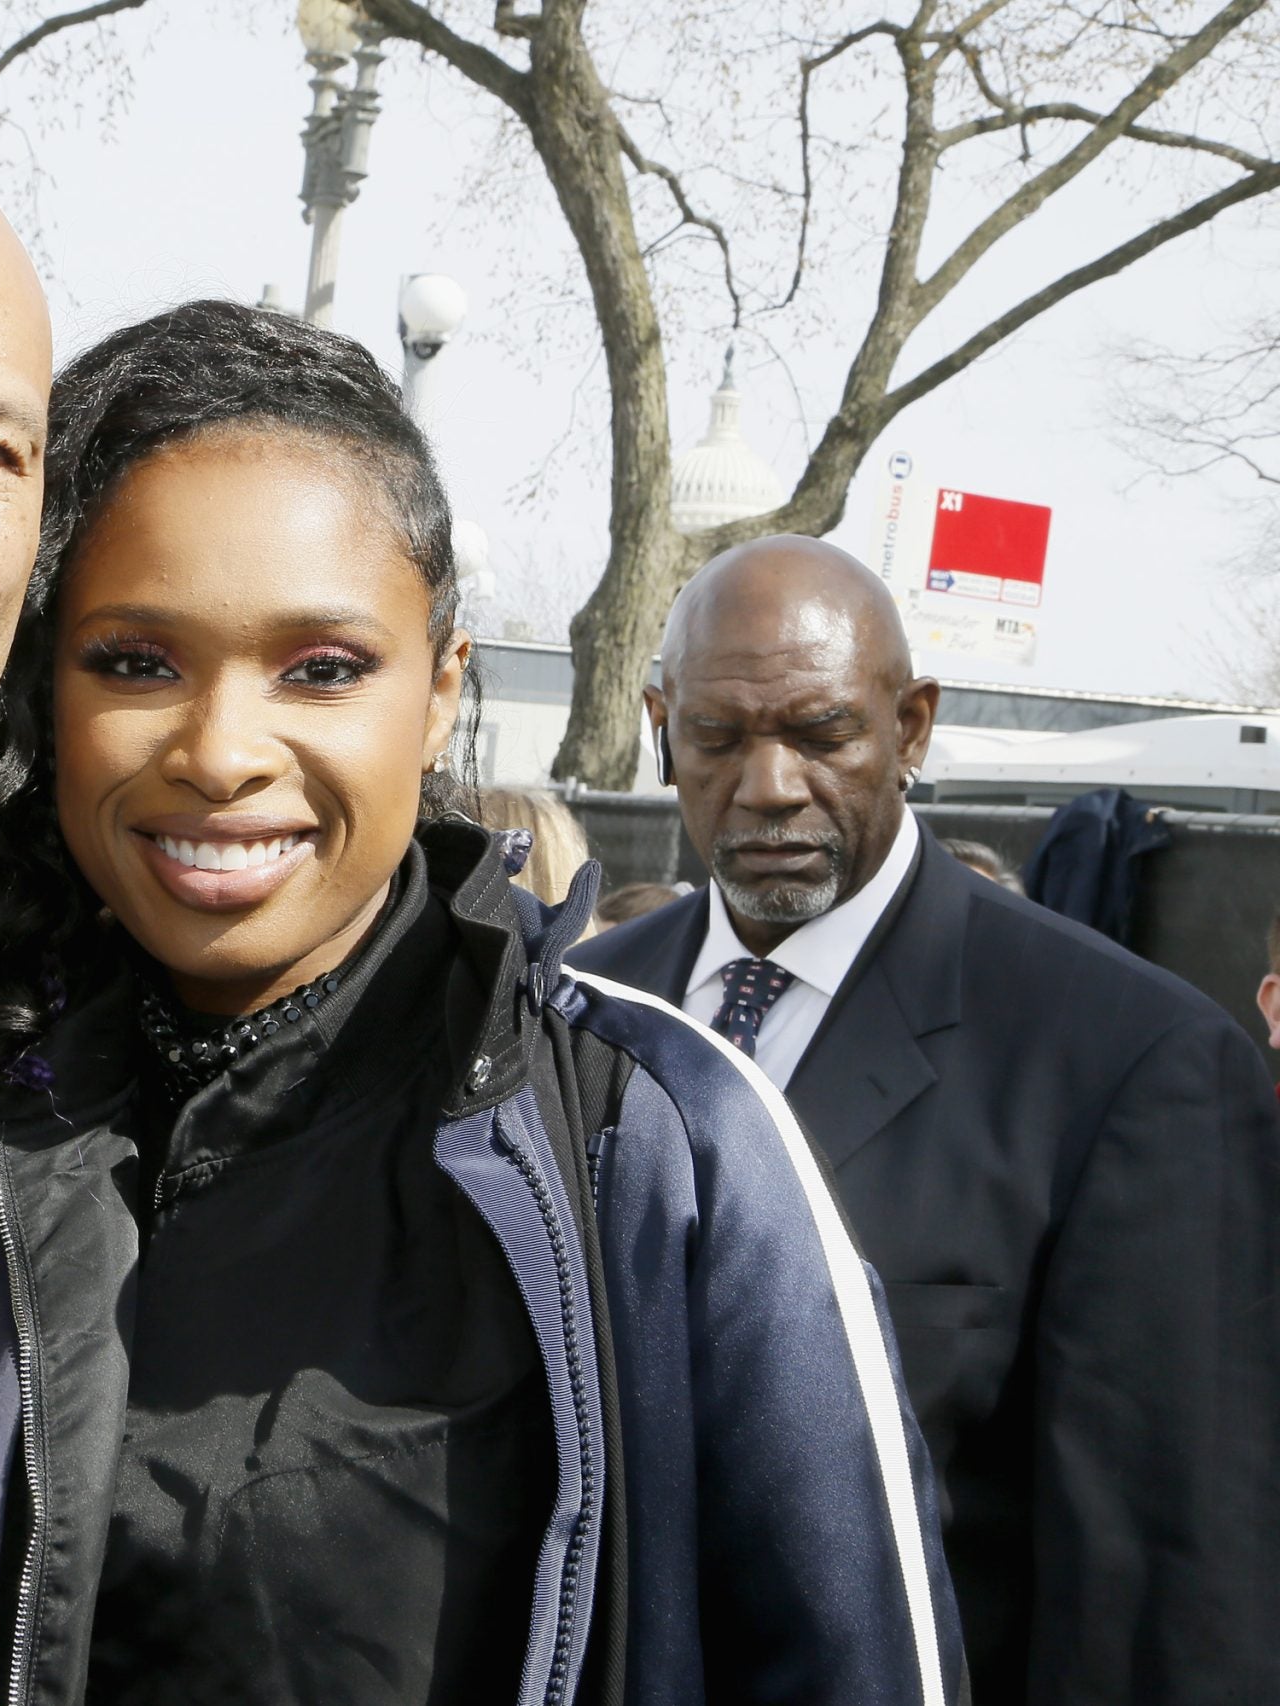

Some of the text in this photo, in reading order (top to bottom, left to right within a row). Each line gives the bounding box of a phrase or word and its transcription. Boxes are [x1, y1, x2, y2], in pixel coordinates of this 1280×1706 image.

[939, 491, 963, 512] X1
[882, 485, 903, 579] metrobus
[995, 618, 1020, 635] MTA
